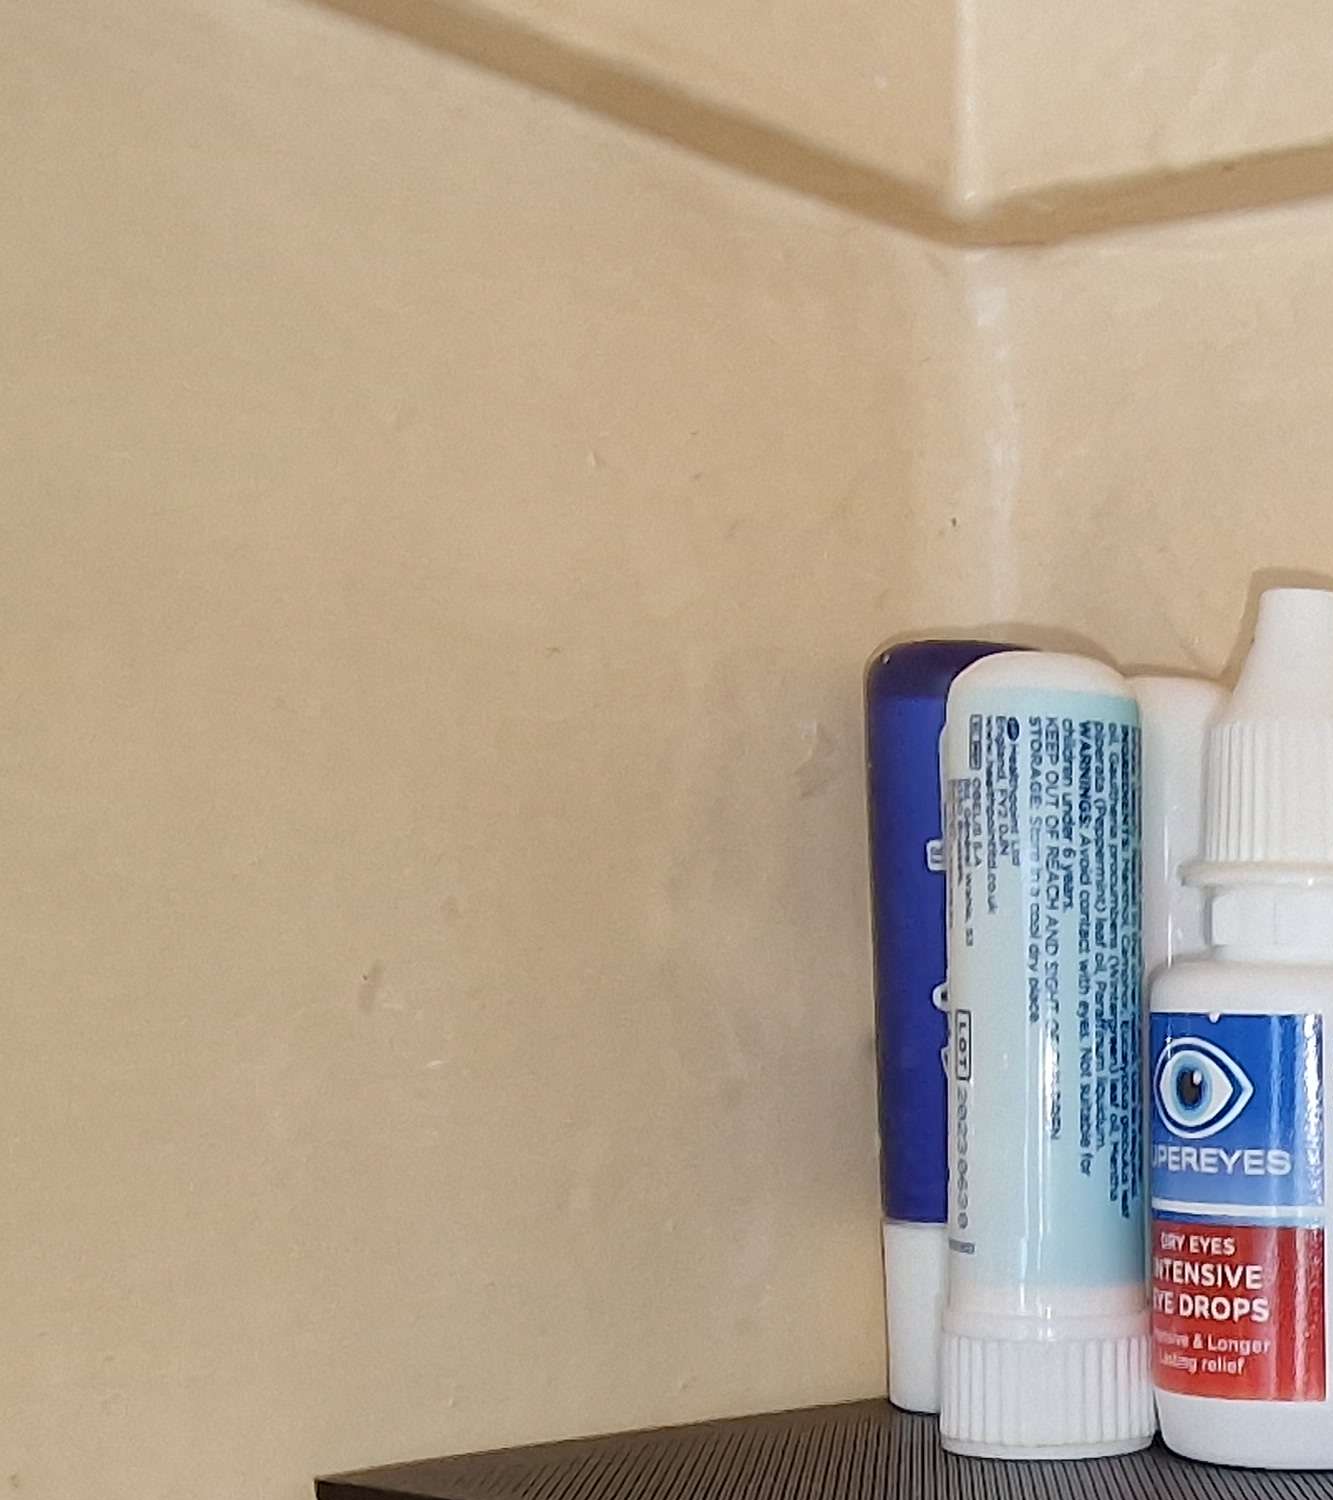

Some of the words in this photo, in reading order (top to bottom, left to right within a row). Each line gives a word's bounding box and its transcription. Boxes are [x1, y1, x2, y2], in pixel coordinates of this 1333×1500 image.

[1045, 716, 1060, 766] KEEP
[1062, 718, 1075, 787] children
[1045, 770, 1060, 810] OUT
[1079, 720, 1092, 829] WARNINGS:
[998, 788, 1008, 819] FY2
[1062, 792, 1074, 842] under
[1029, 814, 1042, 862] Store
[1046, 815, 1060, 840] OF
[1062, 848, 1076, 859] 6
[1080, 833, 1092, 885] Avoid
[1094, 798, 1108, 912] (Peppermint)
[1046, 845, 1060, 910] REACH
[1060, 864, 1074, 913] years.
[1029, 902, 1041, 938] cool
[1045, 915, 1059, 956] AND
[1079, 890, 1091, 954] contact
[1095, 917, 1107, 948] leaf
[1028, 943, 1042, 971] dry
[1079, 959, 1091, 995] with
[1045, 961, 1060, 1014] SIGHT
[959, 1022, 968, 1072] LOT
[1080, 1047, 1092, 1078] Not
[1080, 1082, 1092, 1148] suitable
[1080, 1152, 1094, 1176] for
[1189, 1235, 1236, 1256] EYES
[1179, 1293, 1271, 1323] DROPS
[1207, 1333, 1271, 1356] Longer
[1201, 1356, 1246, 1375] relief
